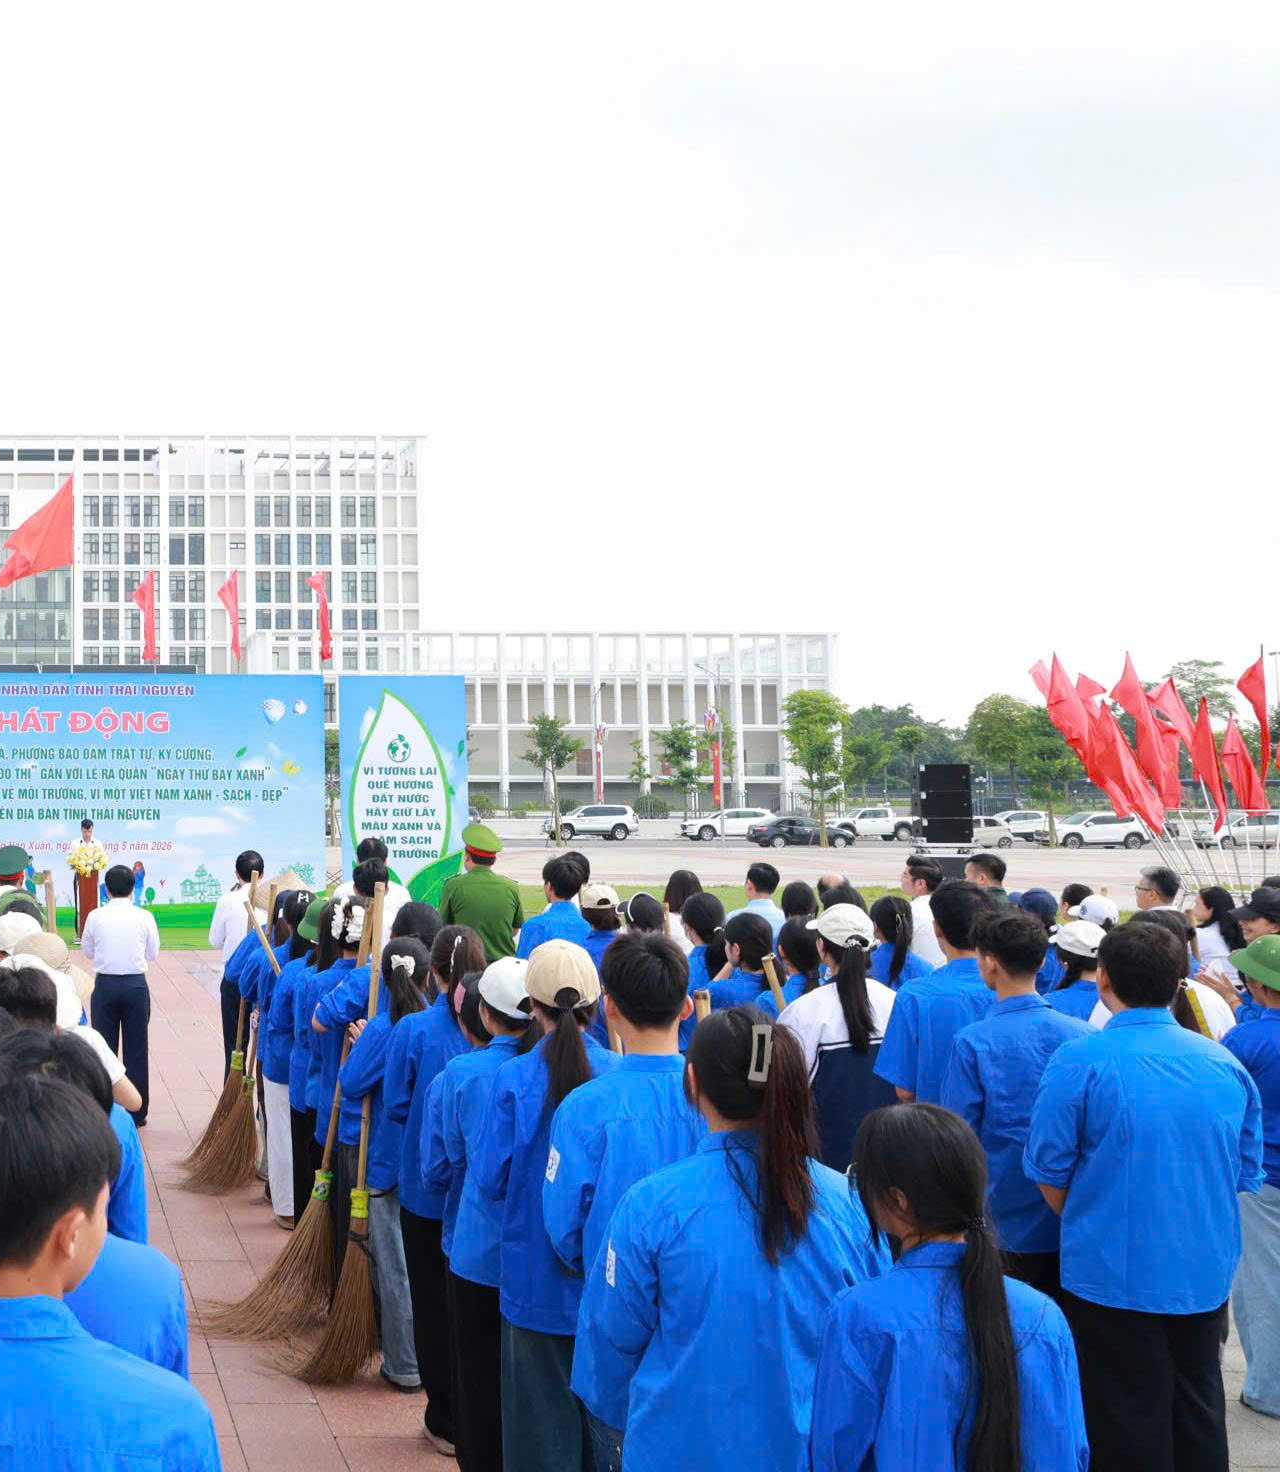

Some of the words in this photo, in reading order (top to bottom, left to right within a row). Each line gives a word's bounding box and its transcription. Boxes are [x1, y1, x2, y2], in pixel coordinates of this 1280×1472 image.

[1, 682, 38, 695] NHÂN
[42, 682, 70, 695] DÂN
[73, 681, 104, 695] TỈNH
[108, 682, 137, 695] THÁI
[141, 682, 195, 696] NGUYÊN
[68, 707, 170, 739] ĐỘNG
[11, 745, 55, 760] PHƯỜNG
[58, 745, 80, 760] BẢO
[83, 745, 107, 760] ĐẢM
[111, 745, 135, 762] TRẬT
[66, 764, 82, 780] VỚI
[101, 768, 115, 780] RA
[119, 765, 147, 781] QUÂN
[189, 765, 209, 780] THỨ
[212, 765, 232, 780] BẢY
[377, 766, 417, 776] TƯƠNG
[419, 767, 437, 776] LAI
[367, 779, 391, 790] QUÊ
[394, 780, 434, 790] HƯƠNG
[1, 785, 15, 802] VỆ
[18, 785, 39, 800] MÔI
[90, 784, 100, 800] VÌ
[103, 785, 126, 803] MỘT
[129, 785, 152, 803] VIỆT
[155, 788, 180, 800] NAM
[183, 788, 212, 801] XANH
[223, 788, 252, 803] SẠCH
[372, 792, 394, 803] ĐẤT
[397, 793, 430, 803] NƯỚC
[16, 807, 34, 823] ĐỊA
[37, 805, 60, 820] BÀN
[63, 804, 88, 820] TỈNH
[91, 805, 113, 820] THÁI
[117, 805, 161, 821] NGUYÊN
[366, 806, 389, 817] HÃY
[392, 806, 412, 817] GIỮ
[415, 805, 436, 817] LẤY
[361, 819, 388, 831] MÀU
[392, 822, 424, 831] XANH
[426, 819, 442, 831] VÀ
[121, 841, 128, 851] 5
[129, 841, 149, 851] năm
[151, 841, 172, 851] 2026
[400, 836, 432, 847] SẠCH
[392, 848, 439, 859] TRƯỜNG
